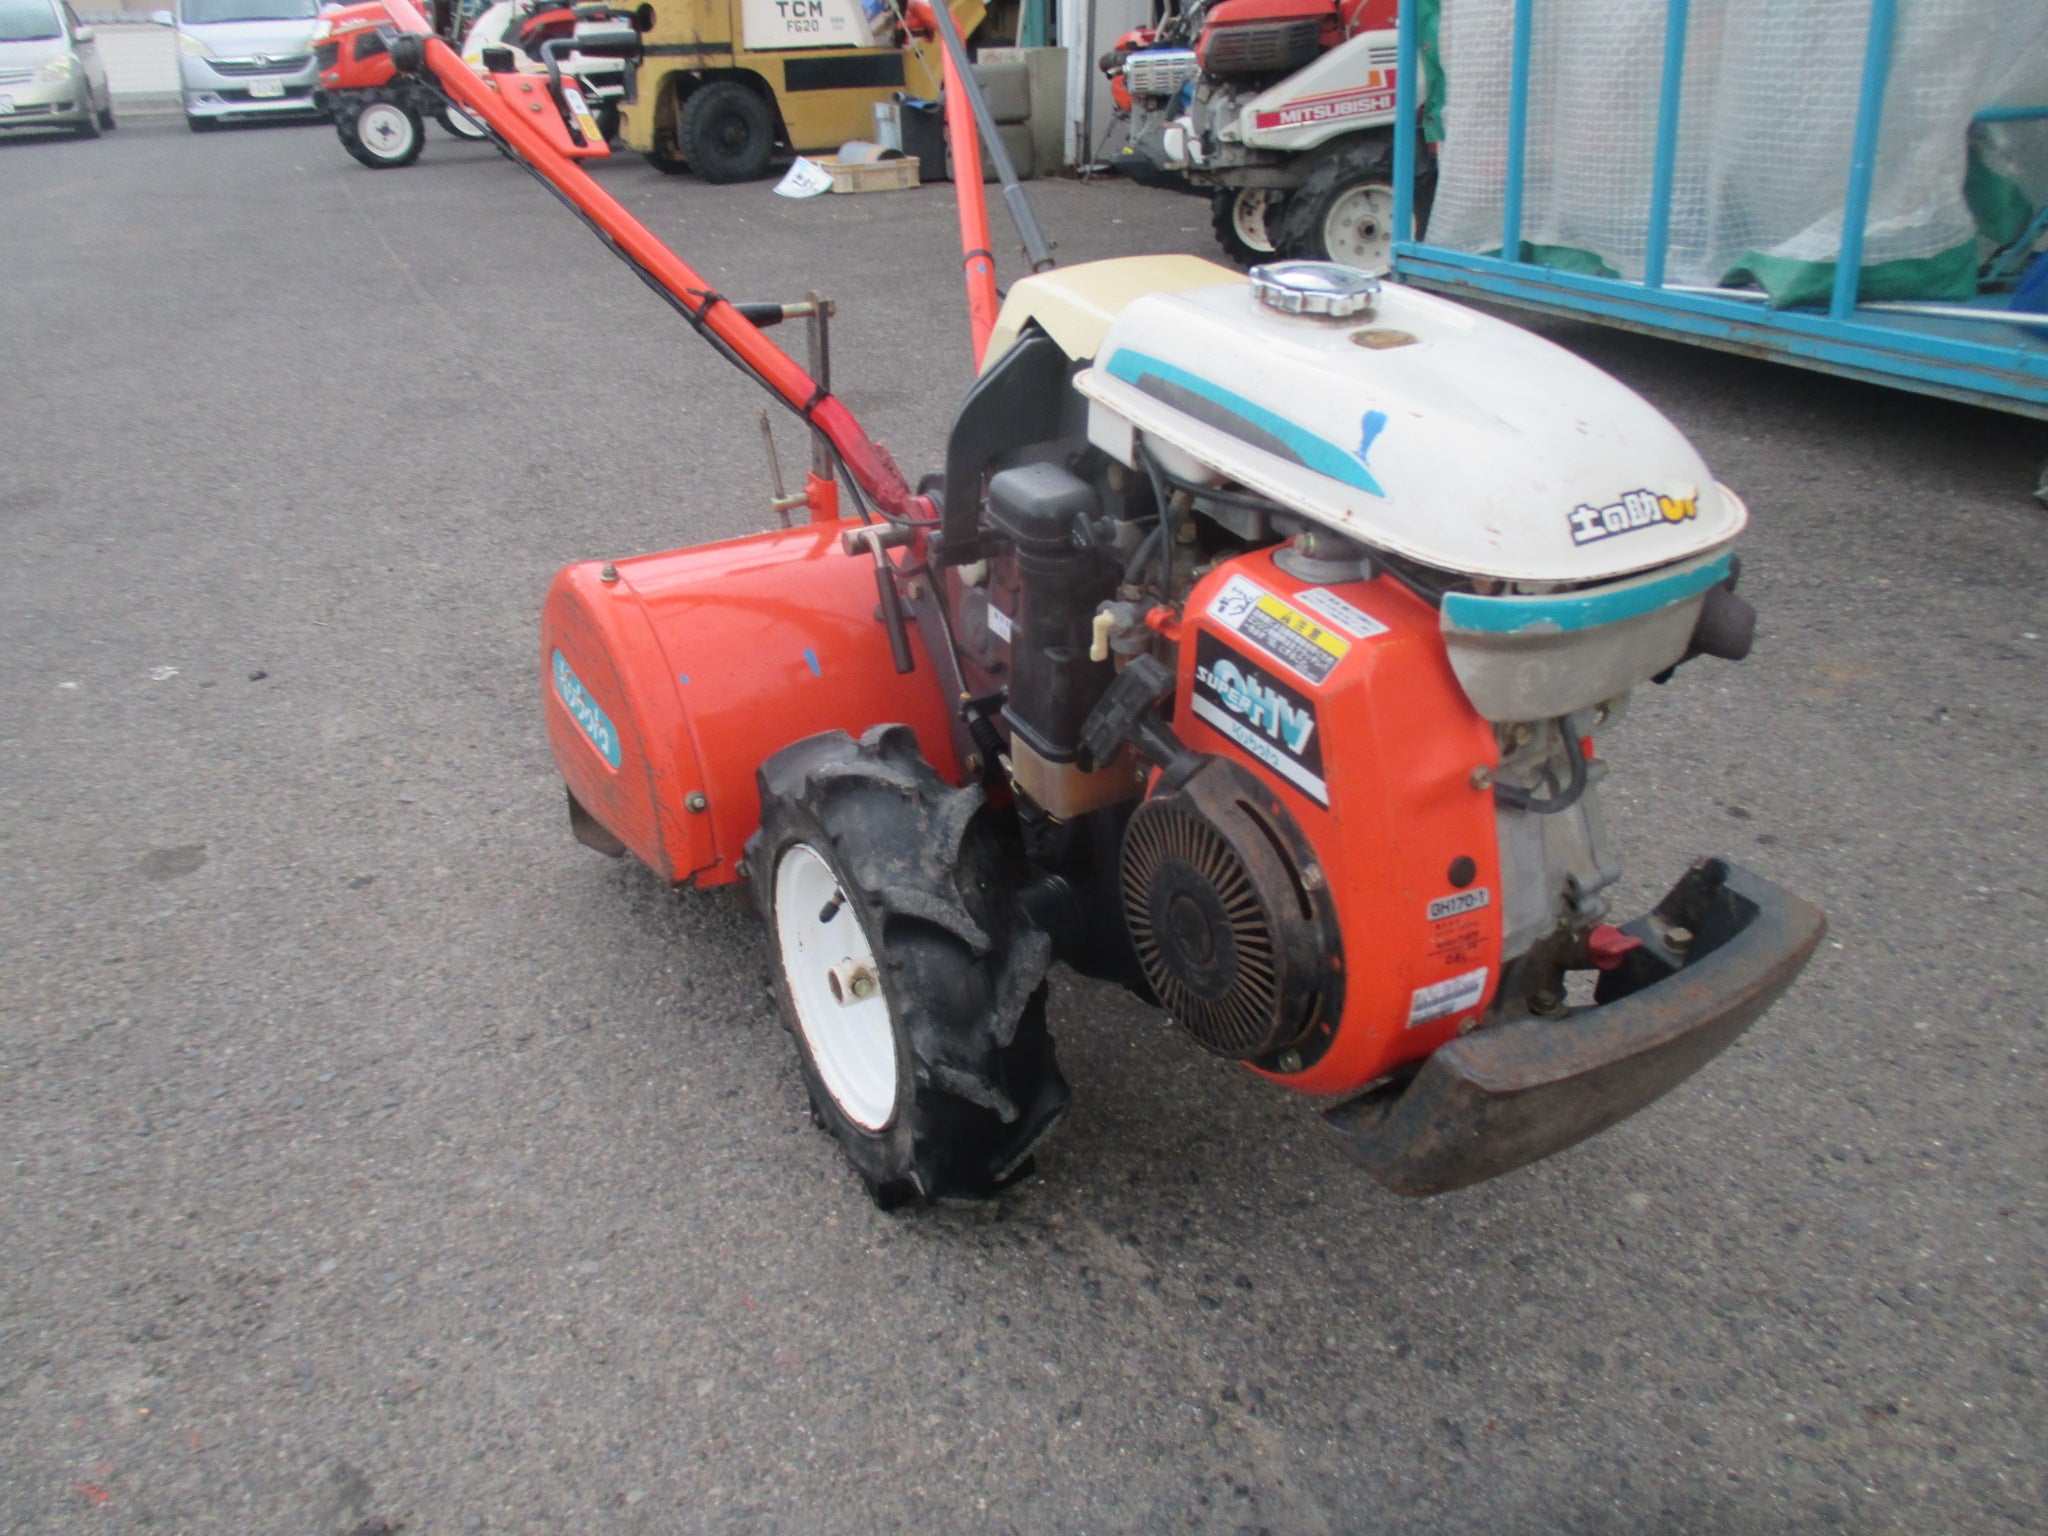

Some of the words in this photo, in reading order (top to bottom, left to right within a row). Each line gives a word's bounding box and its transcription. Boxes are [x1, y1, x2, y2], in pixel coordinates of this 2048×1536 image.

[775, 1, 824, 18] TCM
[786, 19, 820, 32] FG20
[1279, 95, 1391, 125] MITSUBISHI
[1195, 665, 1252, 712] SUPER
[1212, 658, 1315, 756] OHV
[1430, 891, 1485, 916] GH170-1
